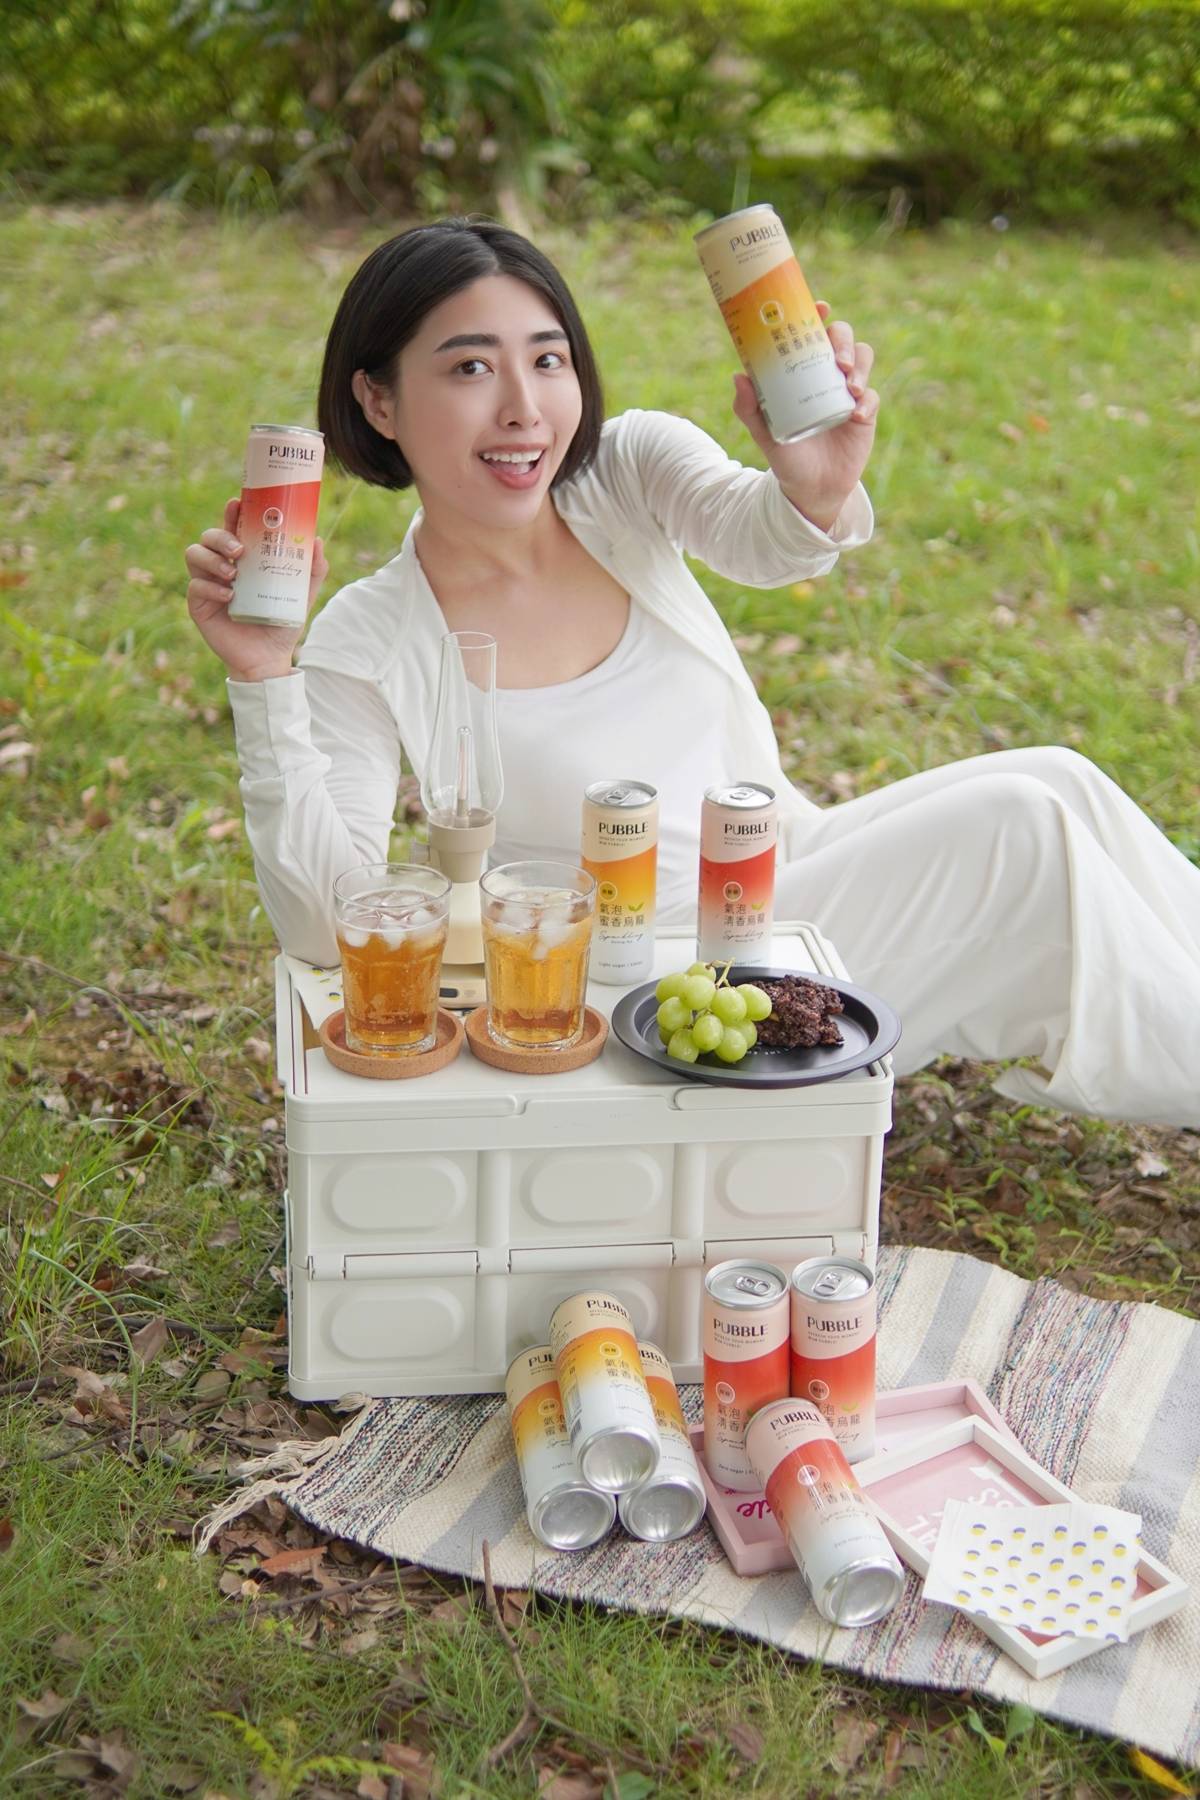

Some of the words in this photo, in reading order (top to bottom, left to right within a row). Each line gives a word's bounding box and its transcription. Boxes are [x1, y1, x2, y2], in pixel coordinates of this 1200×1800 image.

[730, 223, 784, 252] PUBBLE
[269, 444, 317, 461] PUBBLE
[598, 821, 649, 835] PUBBLE
[724, 821, 770, 835] PUBBLE
[713, 1318, 768, 1337] PUBBLE
[807, 1316, 863, 1332] PUBBLE
